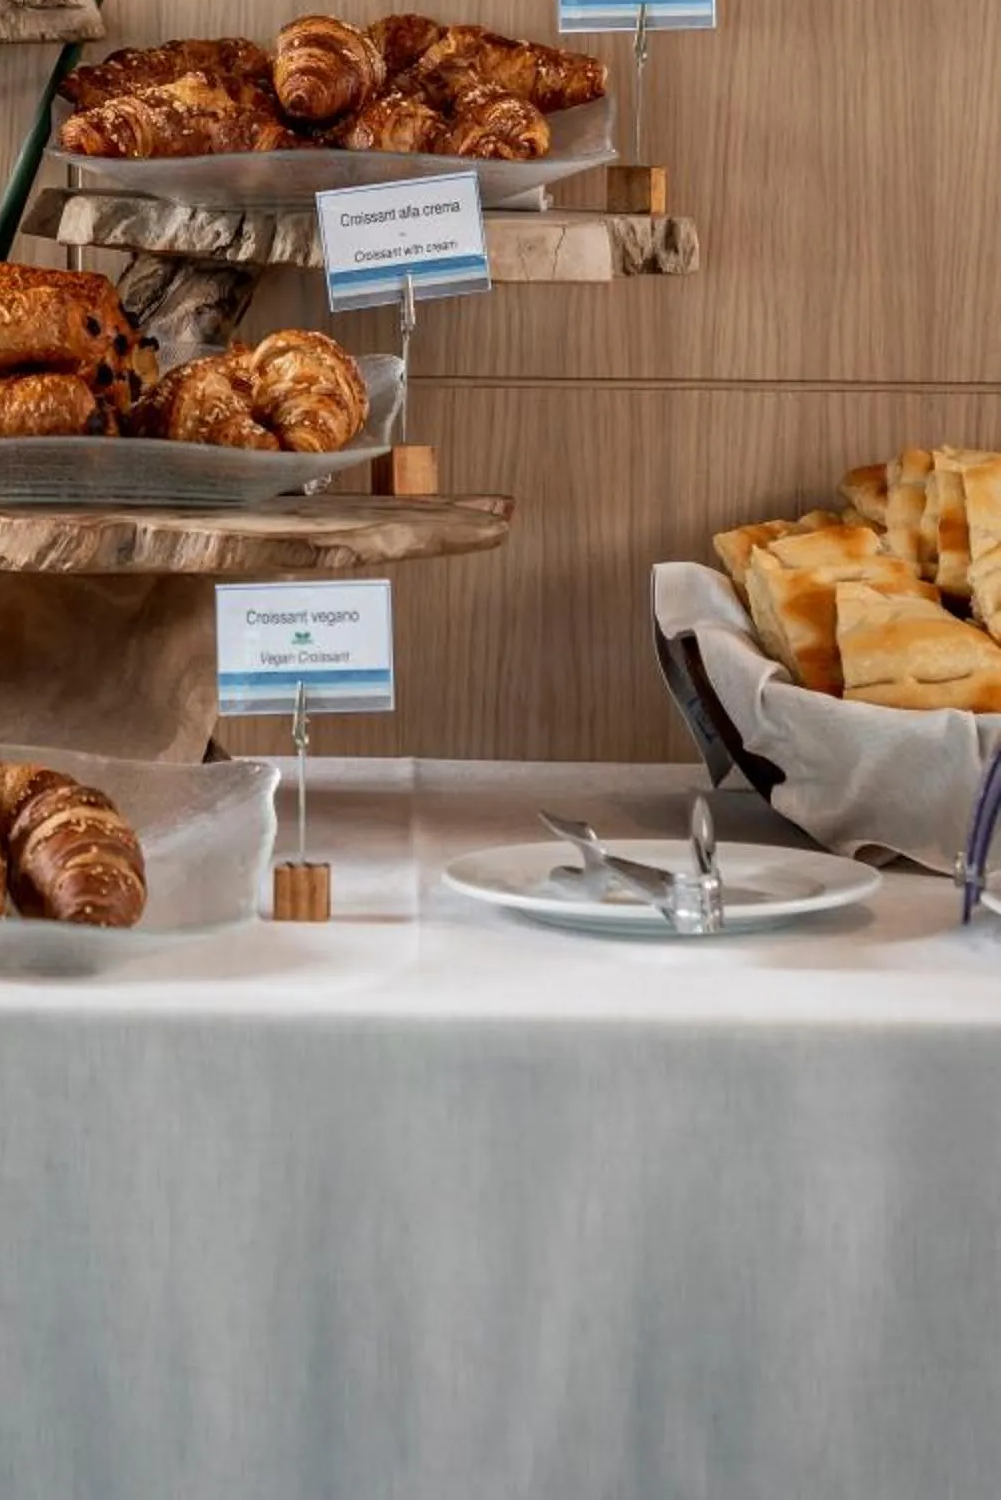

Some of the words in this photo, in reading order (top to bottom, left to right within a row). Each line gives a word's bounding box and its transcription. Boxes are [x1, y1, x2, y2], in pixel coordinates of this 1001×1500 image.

[340, 209, 396, 228] Croissant
[399, 204, 421, 220] alla
[422, 200, 462, 216] crema
[246, 610, 309, 625] Croissant
[311, 610, 361, 626] vegano
[298, 651, 351, 663] Croissant
